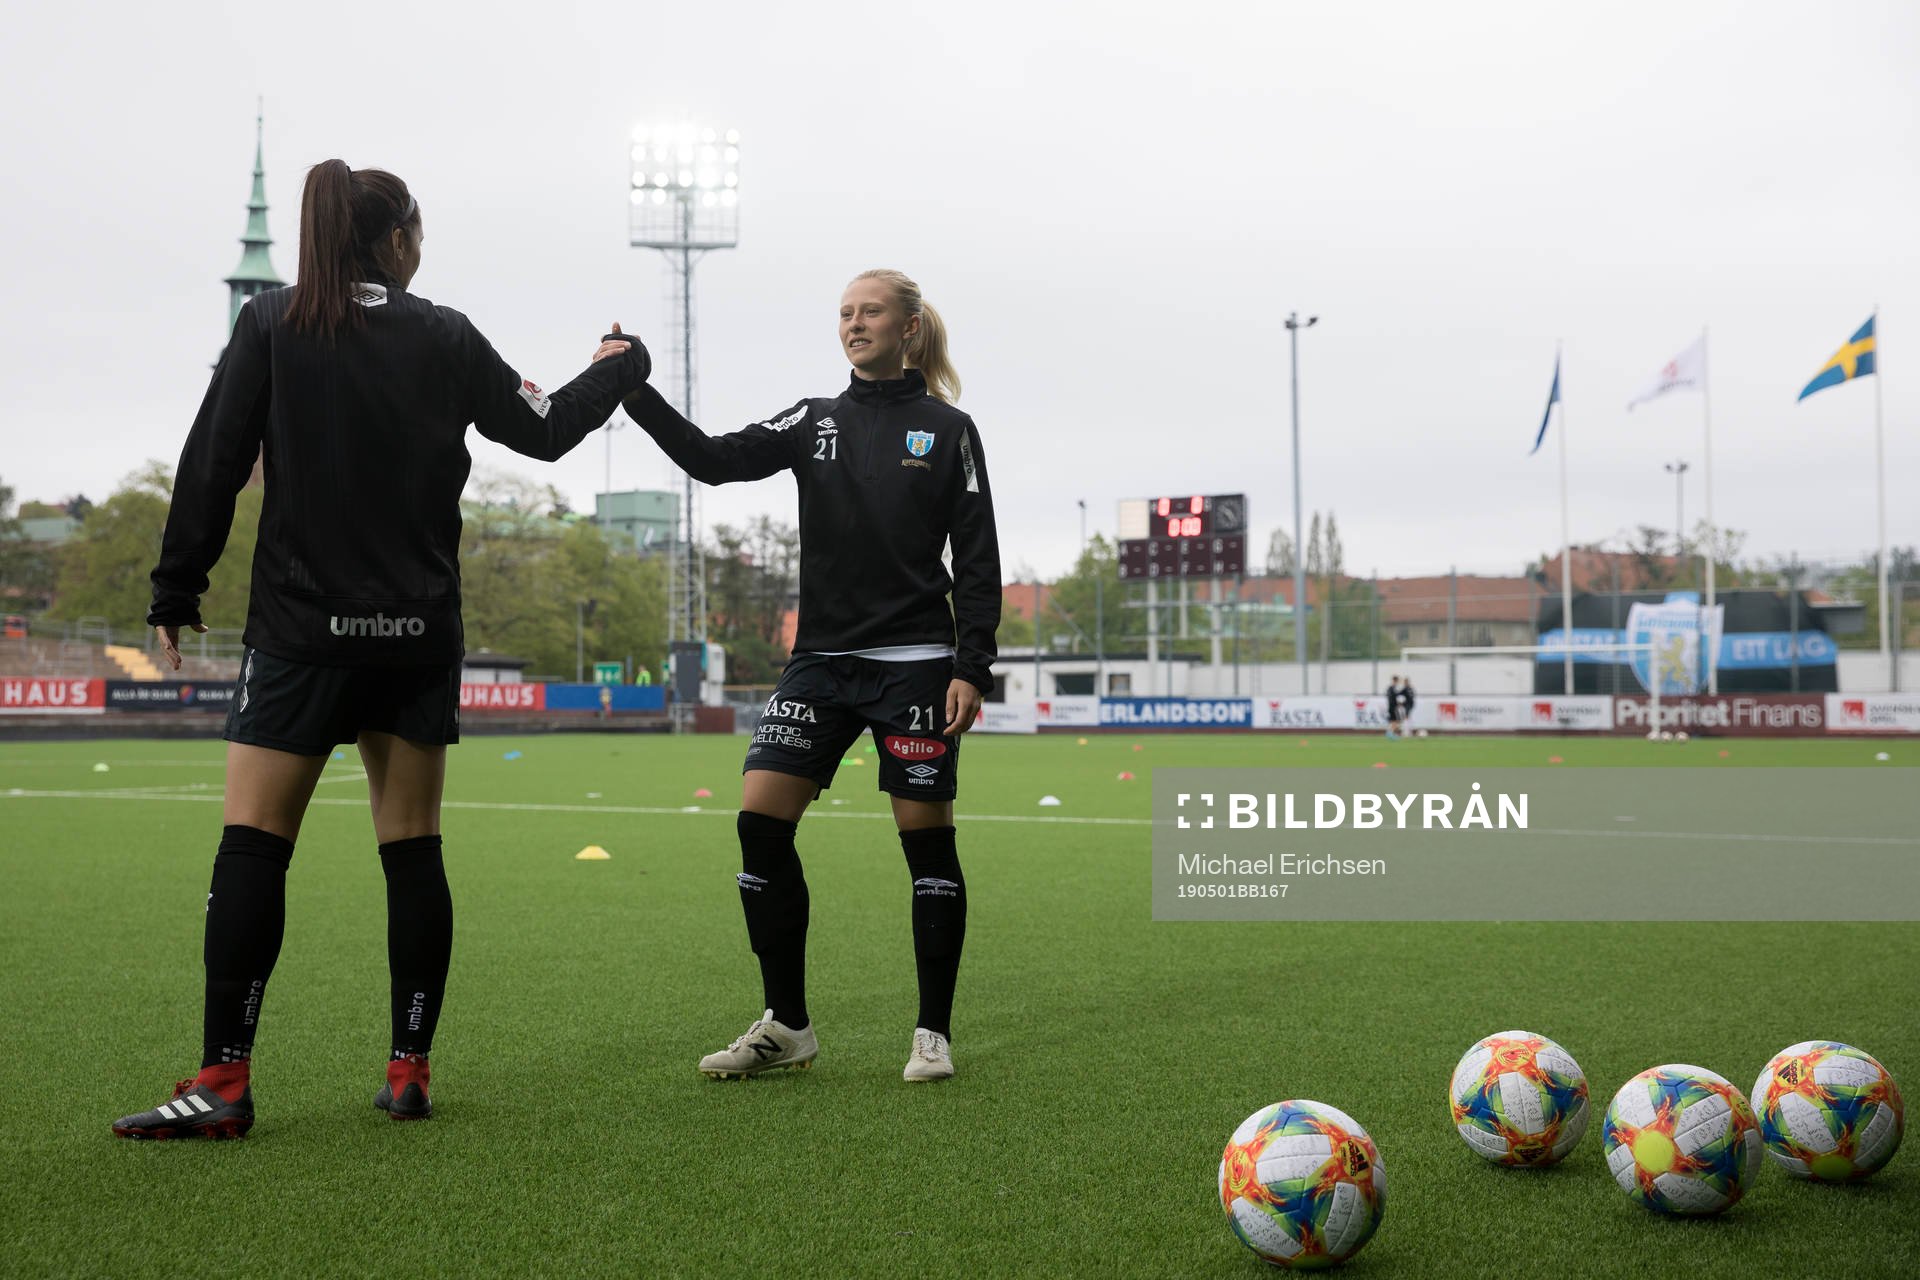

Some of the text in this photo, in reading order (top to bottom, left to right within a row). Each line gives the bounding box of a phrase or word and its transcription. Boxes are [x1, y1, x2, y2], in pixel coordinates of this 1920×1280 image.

[817, 428, 838, 436] umbro
[813, 436, 837, 460] 21
[962, 444, 972, 474] umbro
[330, 612, 425, 637] umbro
[4, 680, 88, 705] HAUS
[908, 705, 934, 731] 21
[1101, 702, 1247, 723] ERLANDSSON
[1732, 698, 1822, 728] Finans
[758, 724, 801, 737] NORDIC
[893, 740, 934, 754] Agillo
[908, 777, 935, 785] umbro
[916, 886, 956, 896] umbro
[244, 980, 262, 1025] umbro
[408, 992, 425, 1031] umbro
